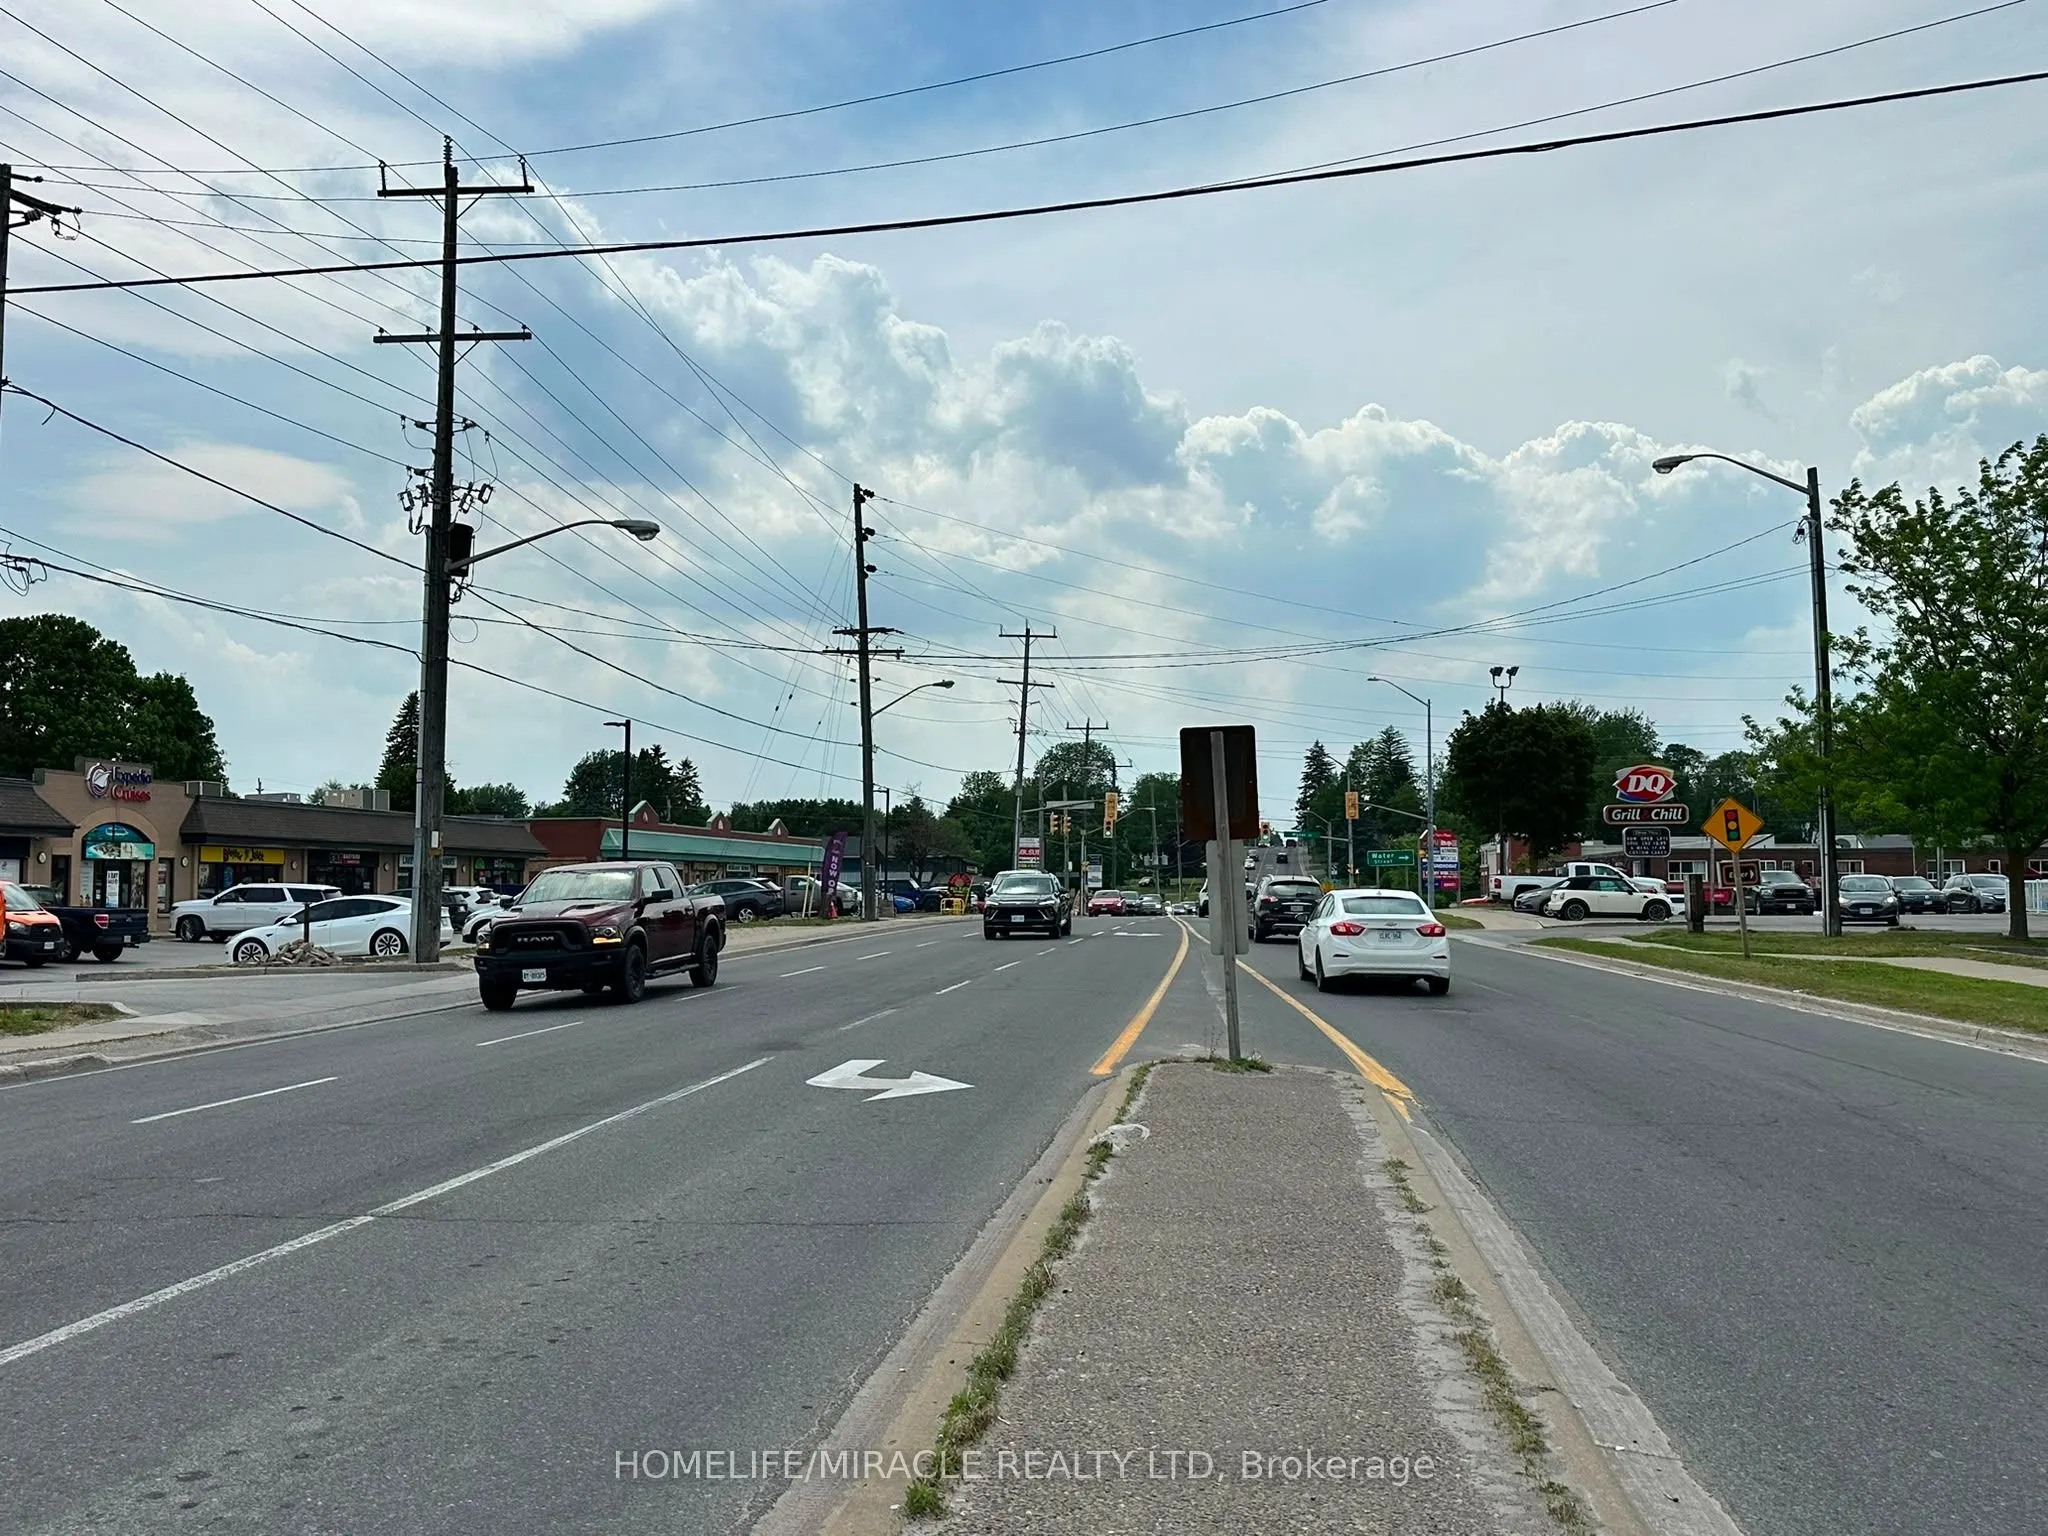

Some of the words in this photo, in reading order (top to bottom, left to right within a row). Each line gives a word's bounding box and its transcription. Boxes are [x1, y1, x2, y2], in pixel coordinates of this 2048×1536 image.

[112, 766, 152, 785] Expedia
[1626, 774, 1666, 794] DQ
[111, 784, 152, 800] Cruises
[1611, 808, 1641, 820] Grill
[1651, 808, 1683, 820] Chill
[829, 855, 838, 878] NOW
